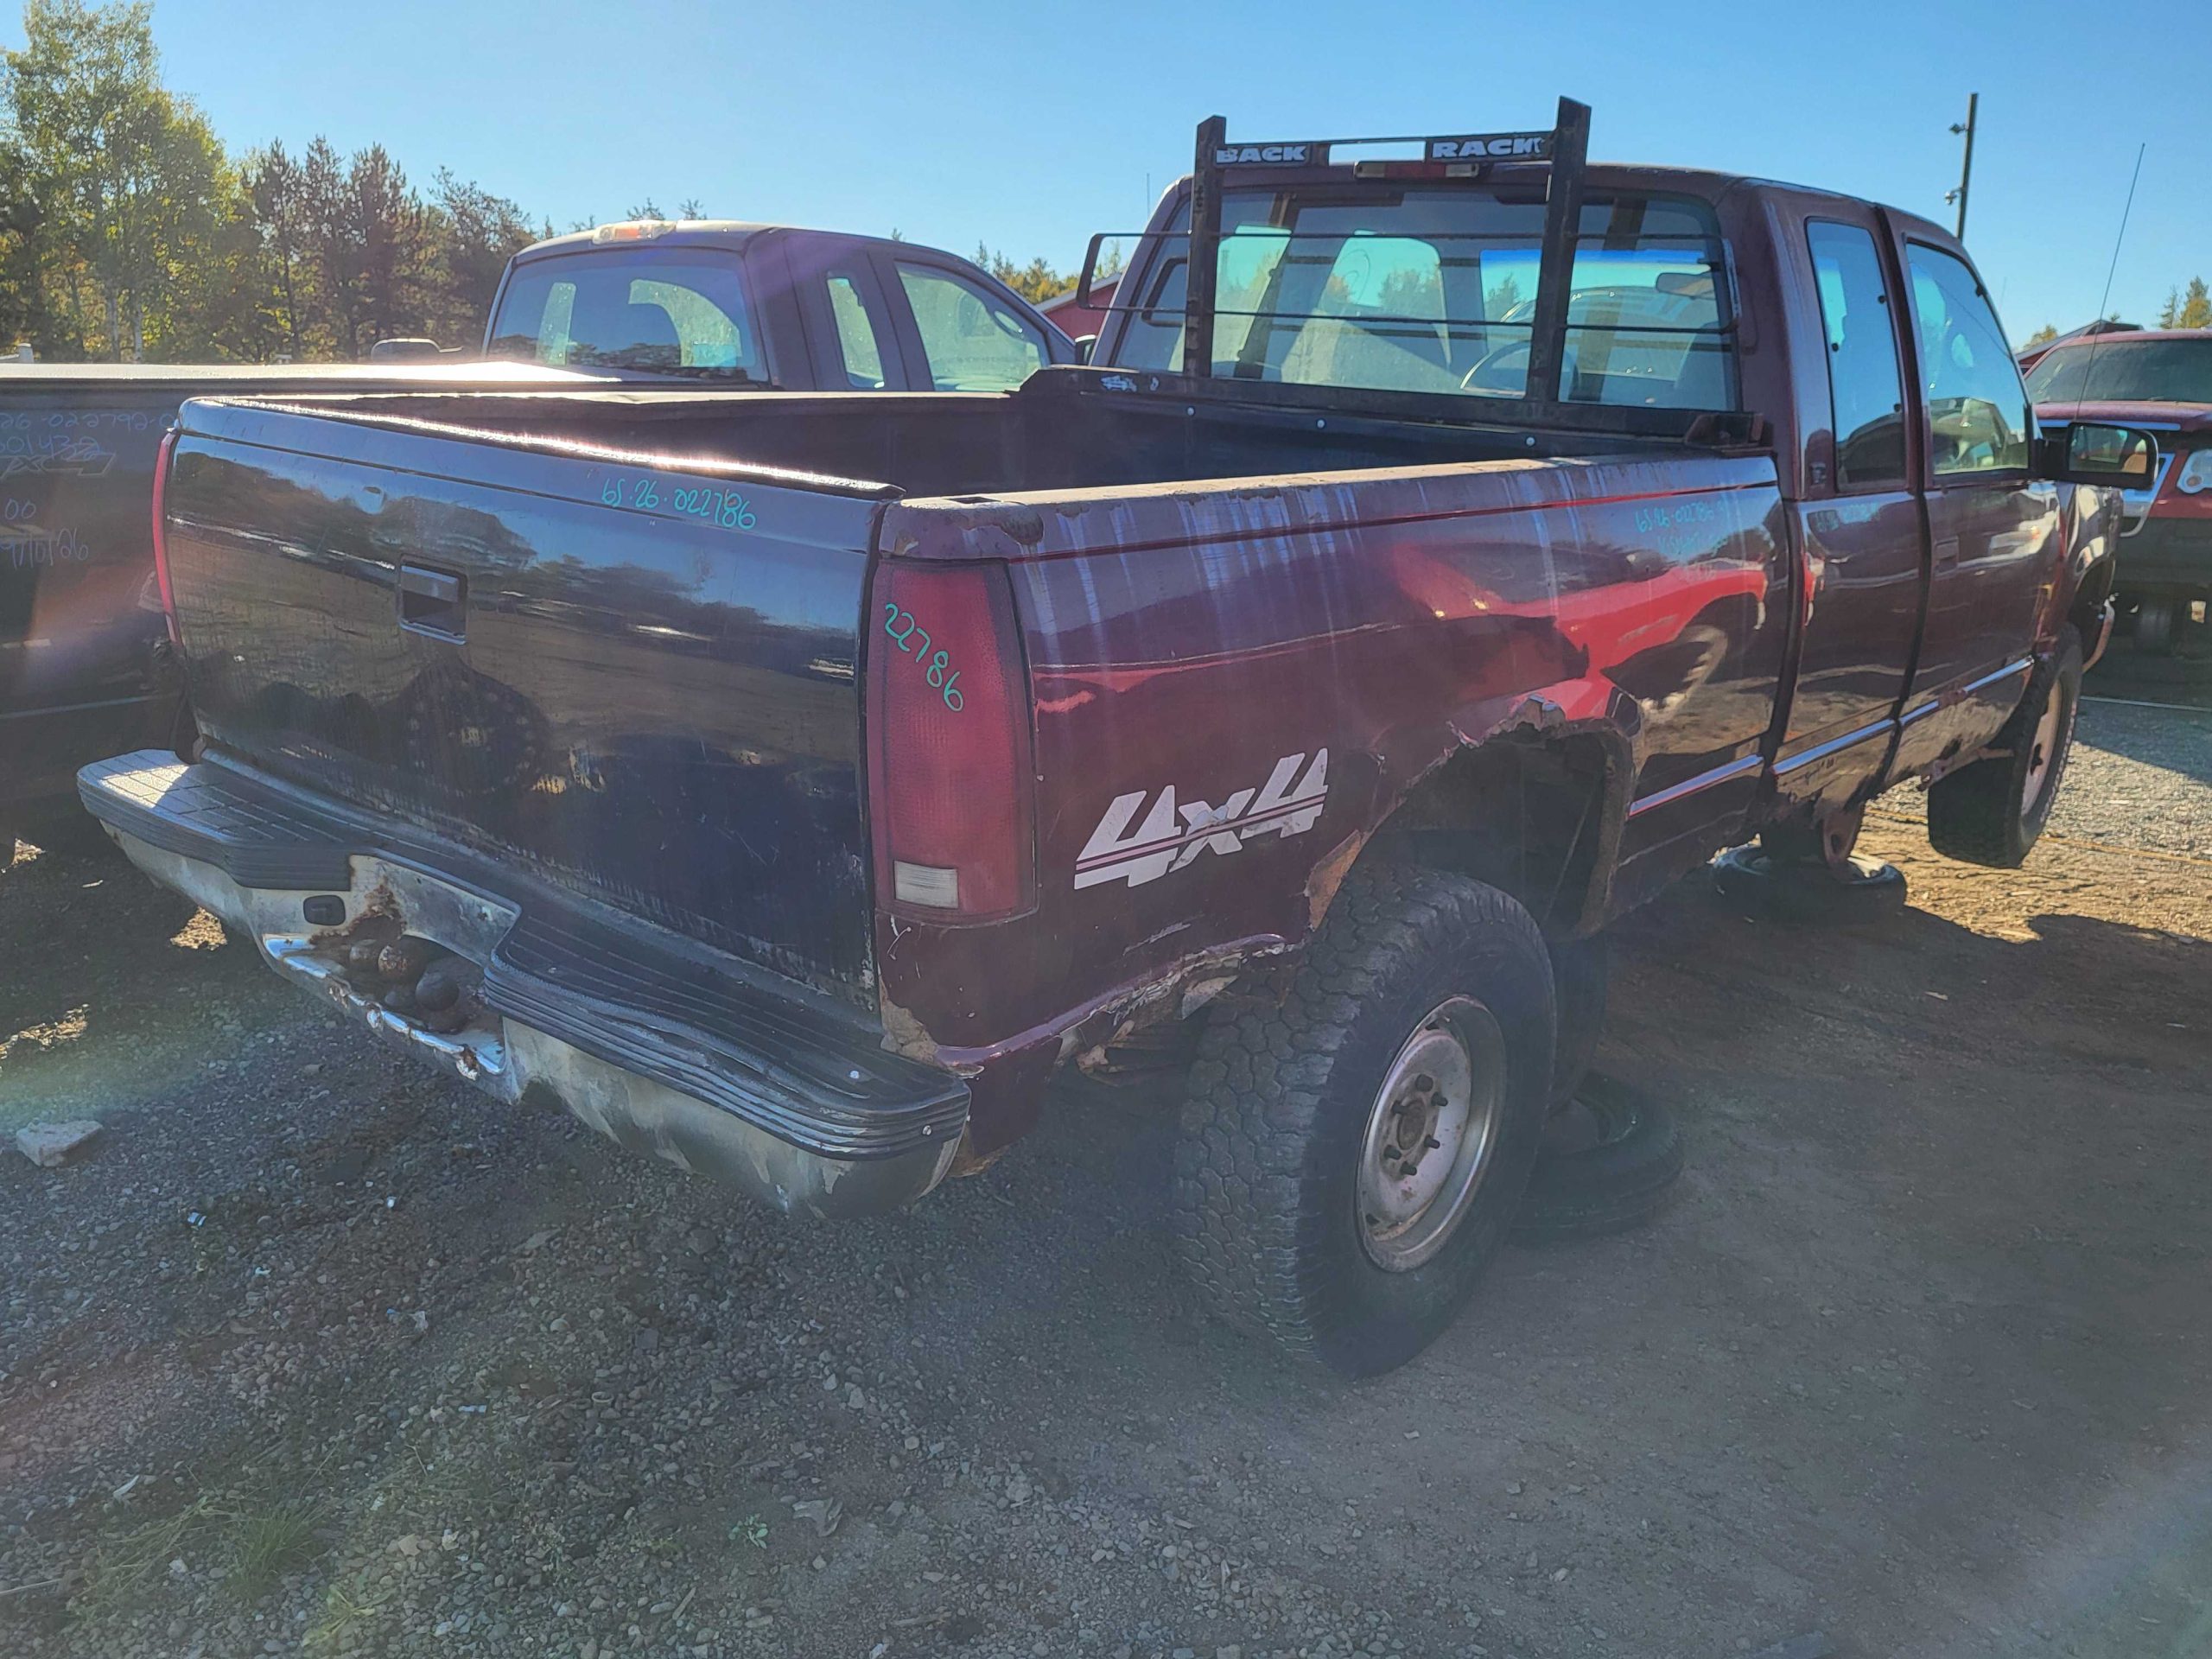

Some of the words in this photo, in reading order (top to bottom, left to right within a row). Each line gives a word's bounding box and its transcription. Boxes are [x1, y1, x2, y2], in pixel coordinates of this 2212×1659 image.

[1216, 145, 1306, 164] BACK
[1432, 137, 1543, 158] RACK
[885, 603, 964, 712] 22786
